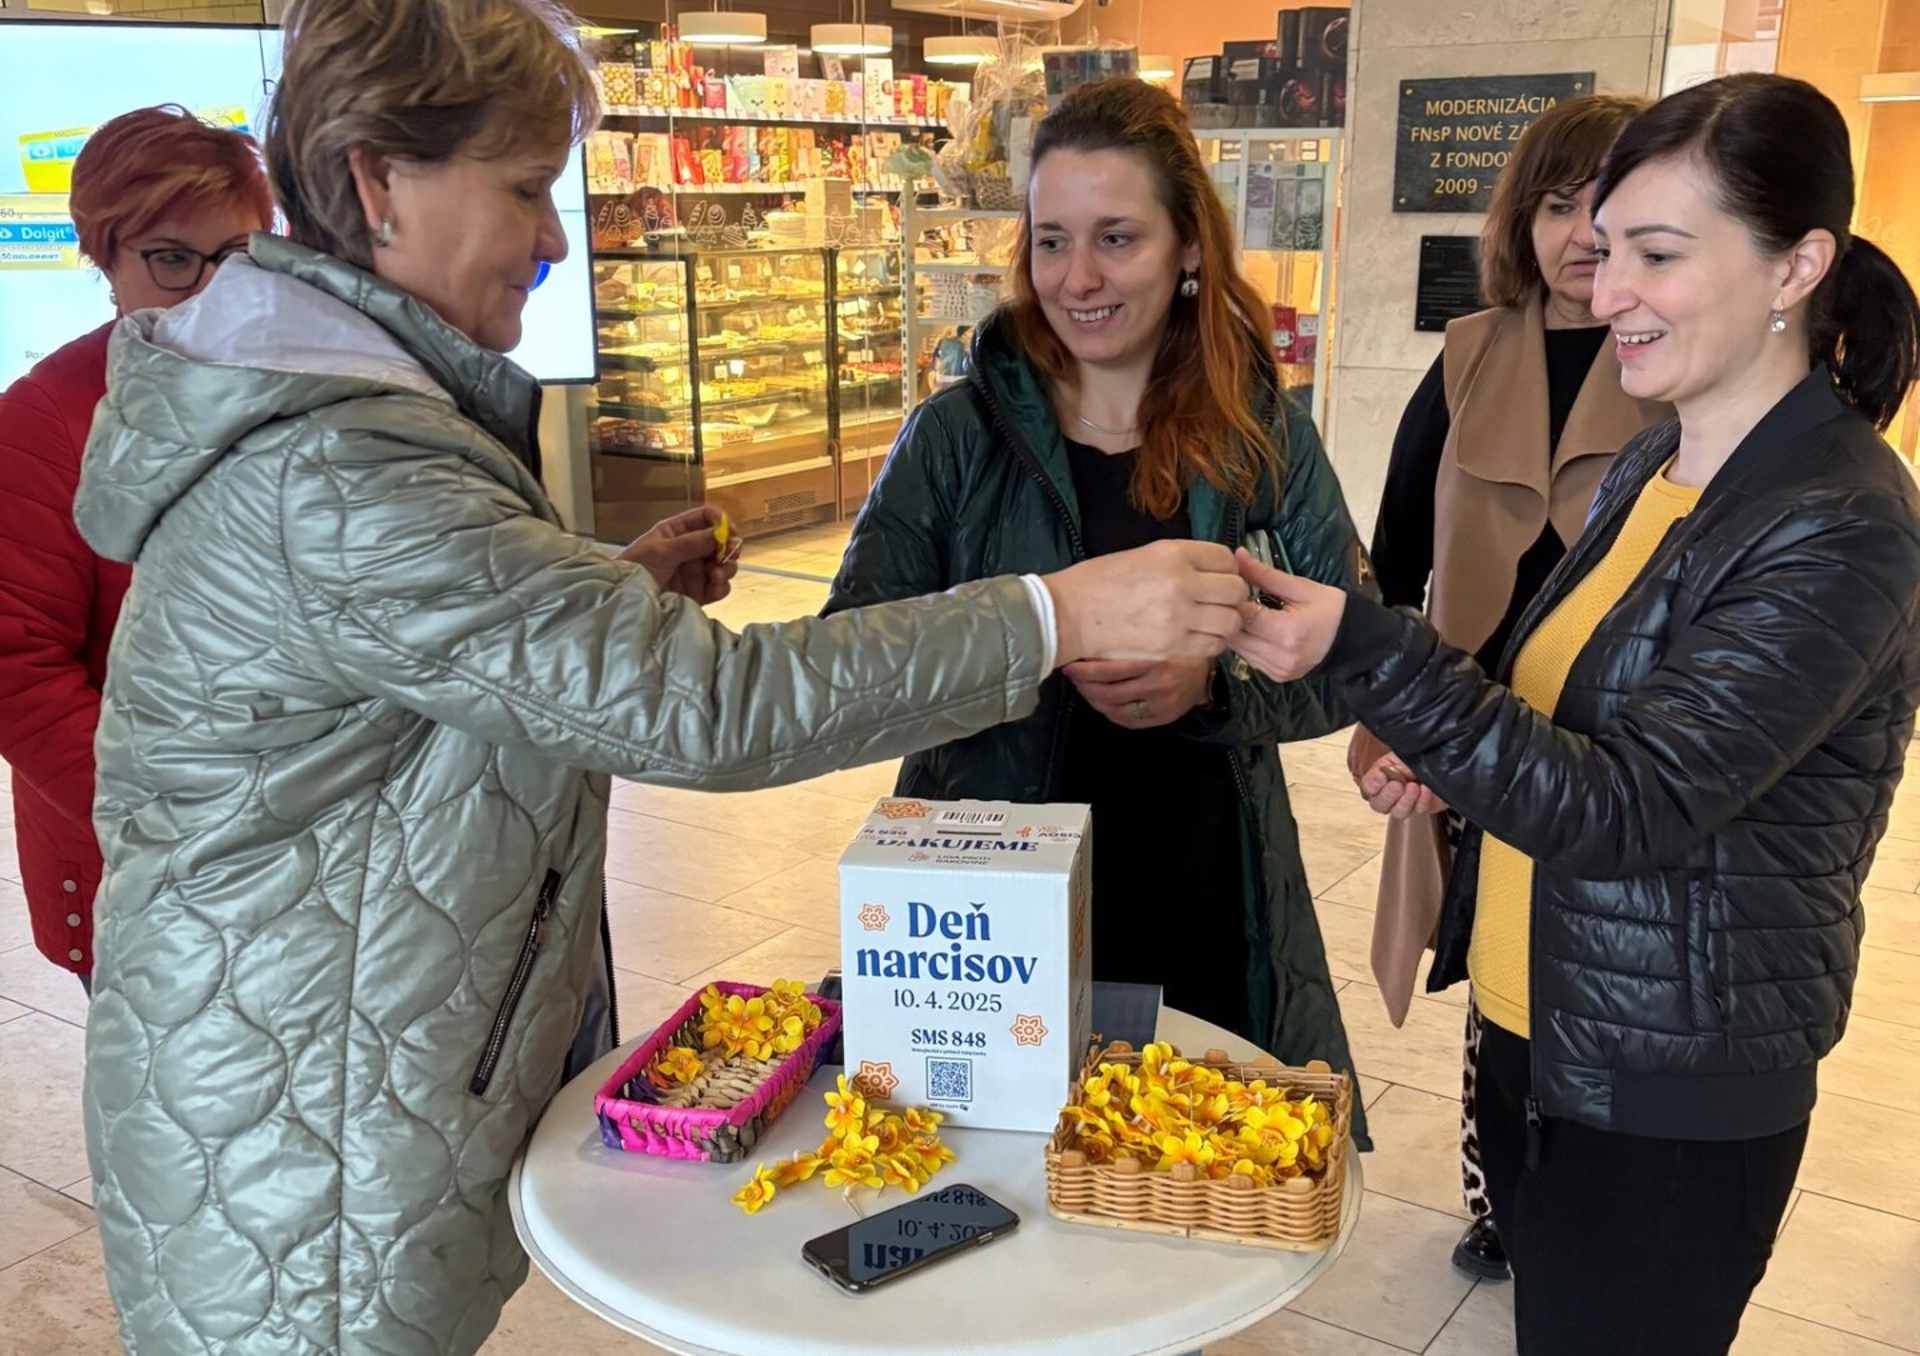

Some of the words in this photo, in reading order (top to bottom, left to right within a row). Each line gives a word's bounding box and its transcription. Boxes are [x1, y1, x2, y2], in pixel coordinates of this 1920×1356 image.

[1425, 94, 1558, 116] MODERNIZÁCIA
[1411, 127, 1452, 142] FNsP
[1456, 121, 1503, 141] NOVÉ
[1430, 152, 1441, 168] Z
[1435, 178, 1478, 194] 2009
[908, 902, 991, 940] Deň
[857, 943, 1038, 984] narcisov
[894, 988, 920, 1009] 10.
[924, 990, 943, 1010] 4.
[947, 991, 1002, 1013] 2025
[911, 1028, 948, 1046] SMS
[951, 1030, 987, 1048] 848
